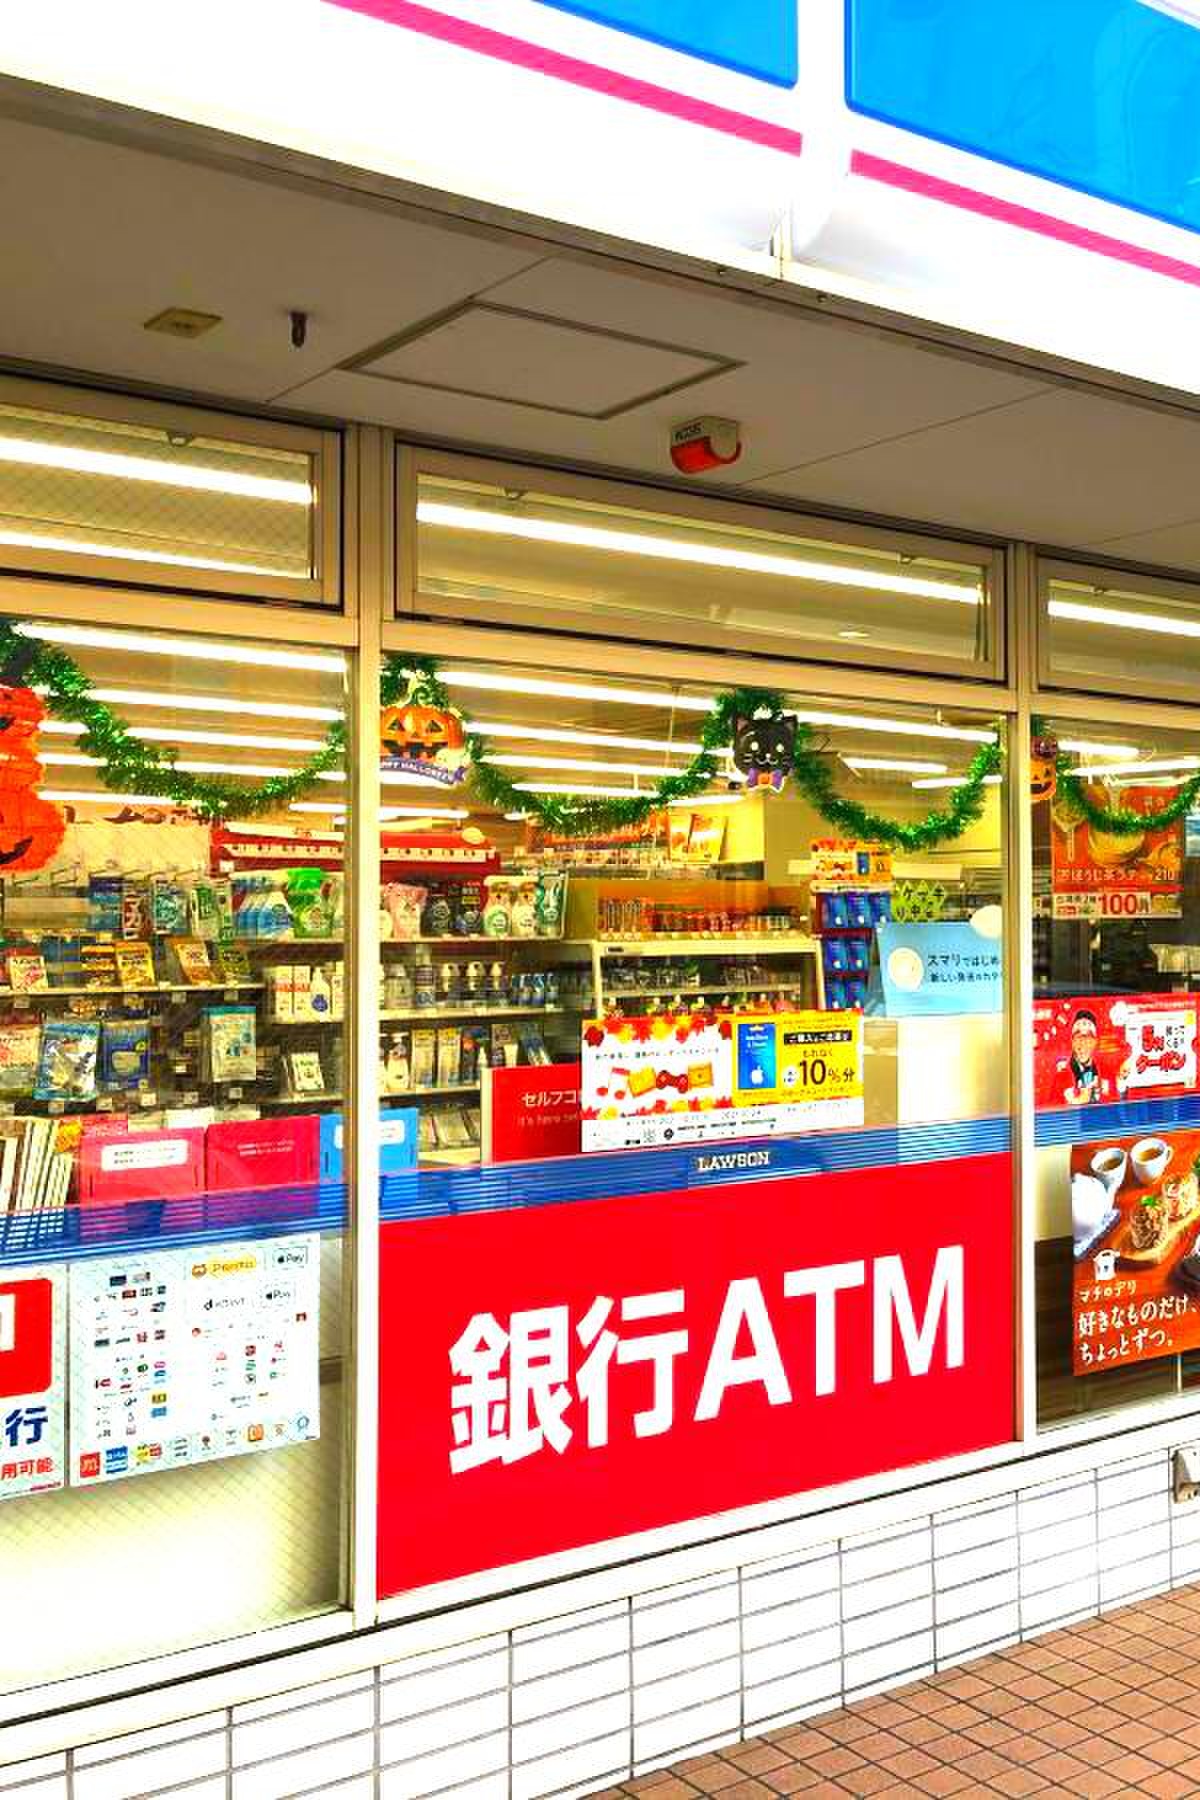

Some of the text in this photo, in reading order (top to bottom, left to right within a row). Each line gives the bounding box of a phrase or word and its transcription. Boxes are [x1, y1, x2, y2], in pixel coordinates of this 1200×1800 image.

[1136, 1052, 1186, 1074] クーポン
[697, 1151, 770, 1173] LAWSON
[1079, 1280, 1137, 1303] マチのデリ
[1078, 1293, 1198, 1338] 好きなものだけ、
[448, 1244, 965, 1475] 銀行ATM
[1079, 1327, 1173, 1366] ちょっとずつ。
